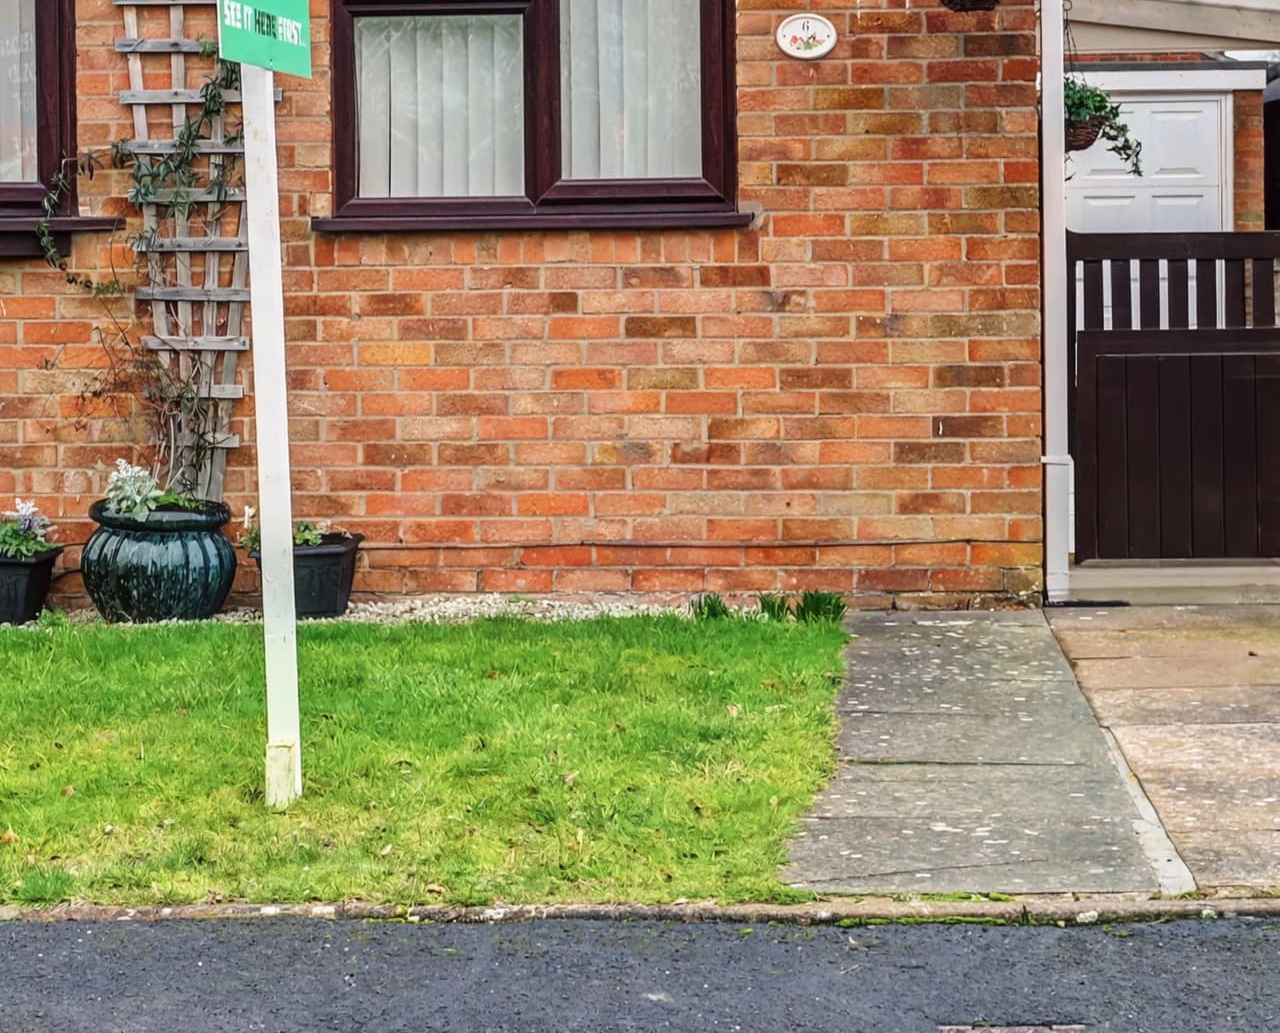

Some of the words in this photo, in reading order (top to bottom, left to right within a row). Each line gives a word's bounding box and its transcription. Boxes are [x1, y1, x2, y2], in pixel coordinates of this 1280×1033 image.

[243, 4, 253, 33] IT
[254, 8, 277, 39] HERE
[802, 20, 810, 32] 6
